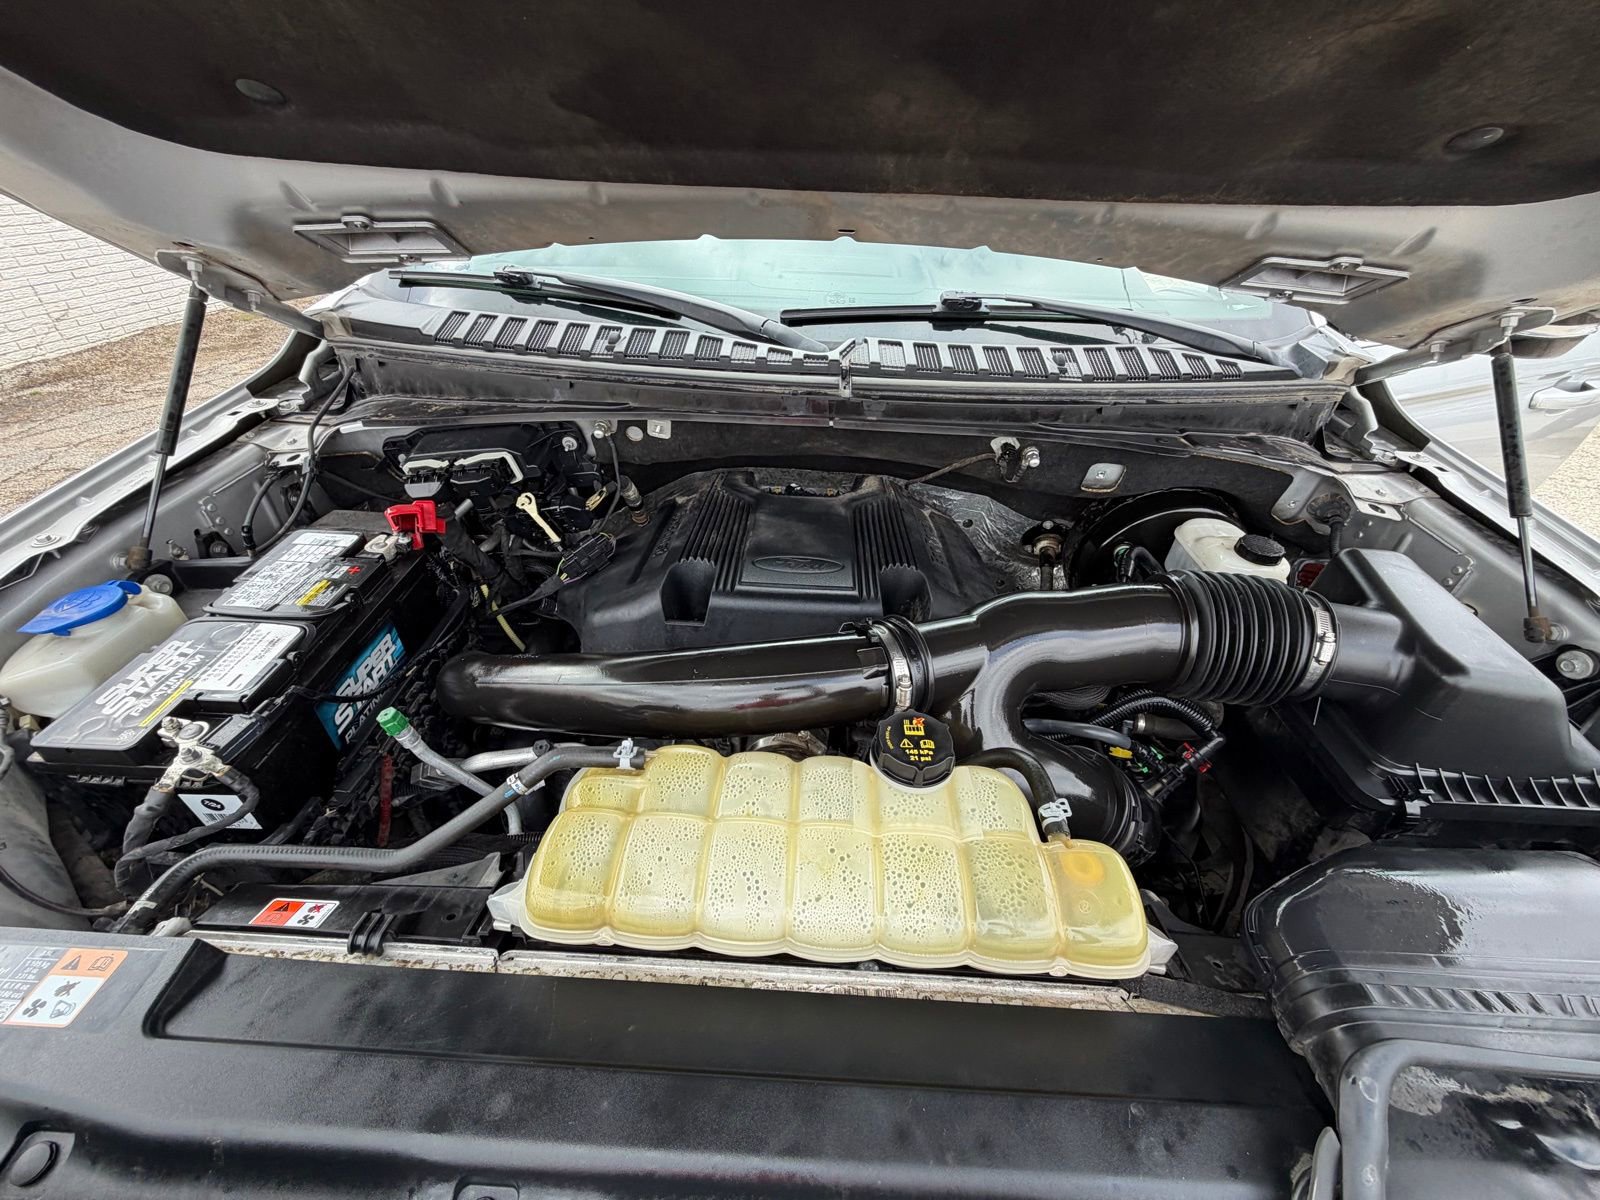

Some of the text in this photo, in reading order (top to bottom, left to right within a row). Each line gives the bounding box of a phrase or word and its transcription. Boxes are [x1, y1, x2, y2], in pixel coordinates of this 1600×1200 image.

[95, 640, 185, 706] SUPER
[101, 640, 195, 718] START
[129, 654, 206, 717] PLATINUM
[335, 644, 397, 735] START
[336, 633, 393, 709] SUPER
